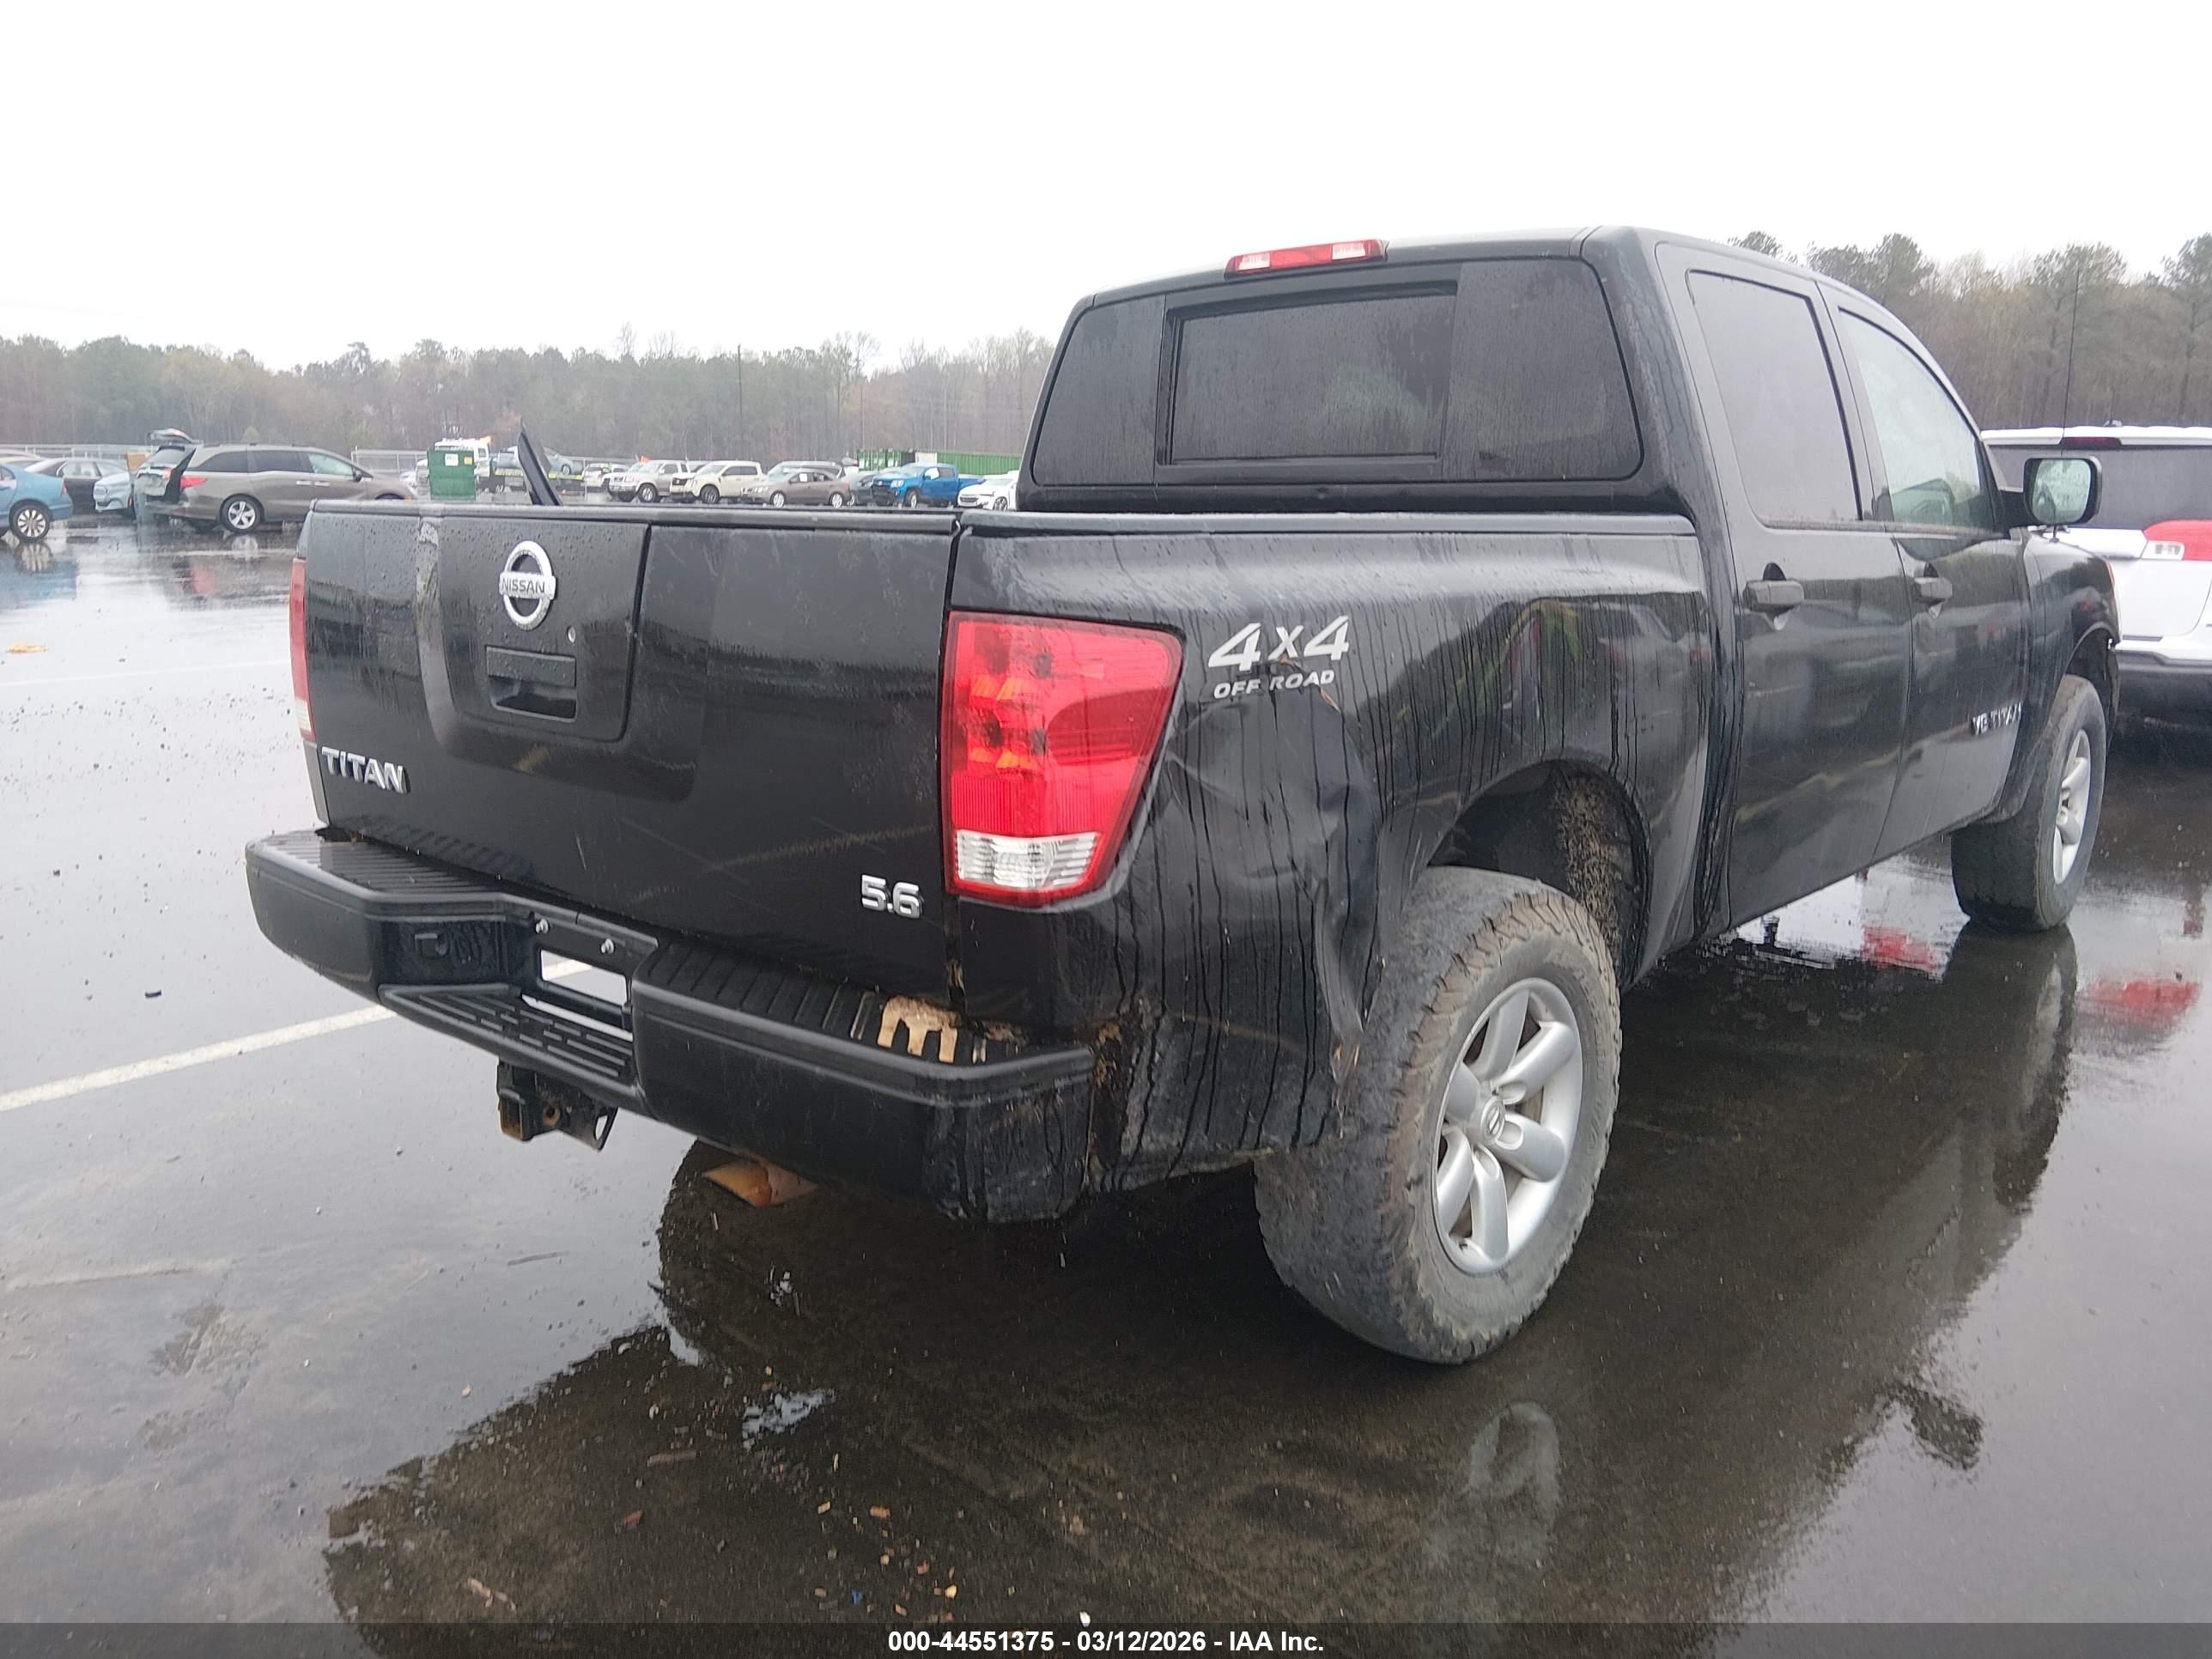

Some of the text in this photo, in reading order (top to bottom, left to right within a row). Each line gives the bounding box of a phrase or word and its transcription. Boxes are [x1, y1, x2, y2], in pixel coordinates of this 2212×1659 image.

[502, 578, 545, 594] NISSAN
[1213, 670, 1334, 699] OFF ROAD
[322, 746, 408, 793] TITAN
[861, 874, 921, 919] 5.6
